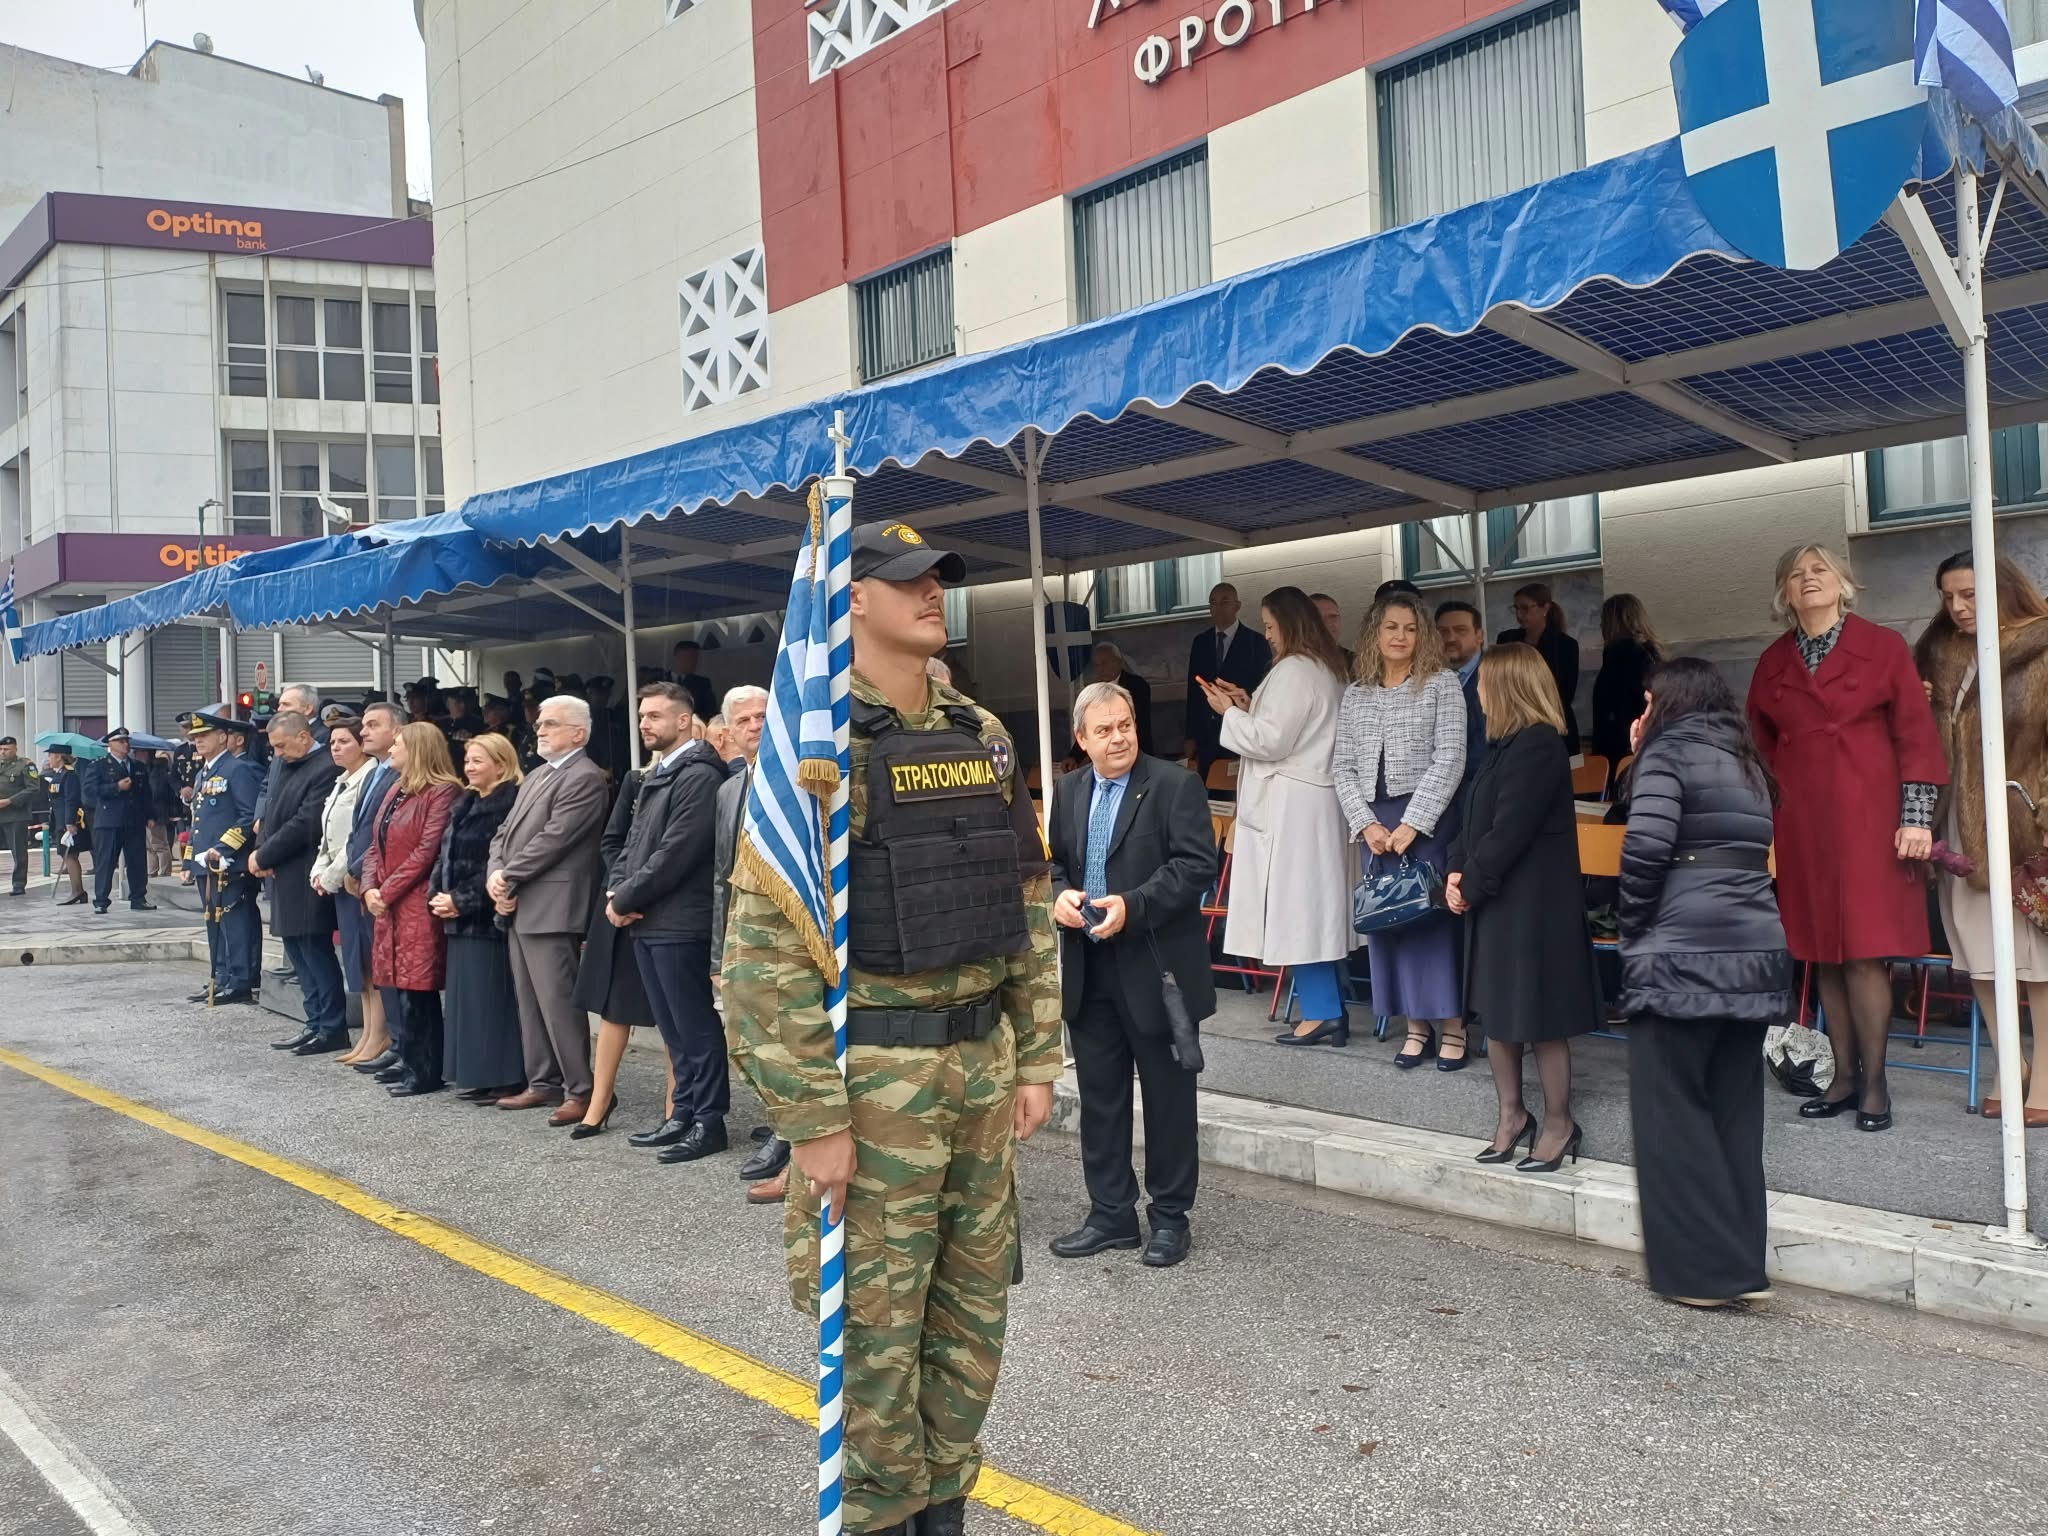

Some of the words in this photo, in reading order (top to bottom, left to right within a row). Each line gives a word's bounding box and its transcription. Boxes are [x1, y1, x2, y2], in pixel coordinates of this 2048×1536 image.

[1133, 0, 1316, 83] ΦΡΟΥ
[146, 209, 262, 238] Optima
[236, 238, 267, 249] bank
[891, 760, 996, 792] ΣΤΡΑΤΟΝΟΜΙΑ
